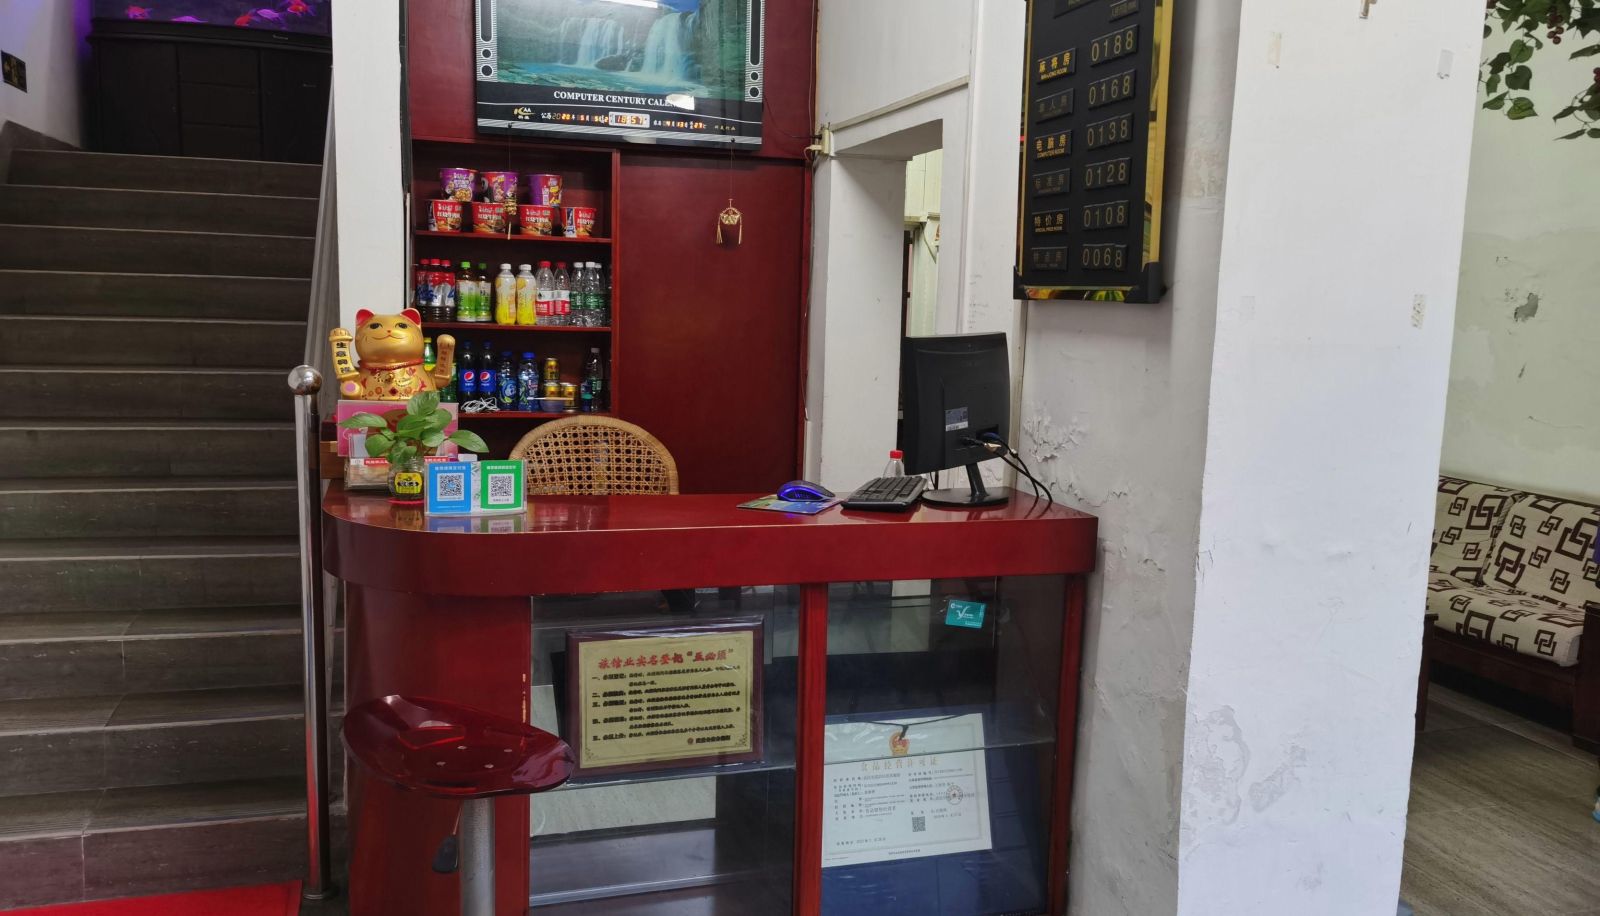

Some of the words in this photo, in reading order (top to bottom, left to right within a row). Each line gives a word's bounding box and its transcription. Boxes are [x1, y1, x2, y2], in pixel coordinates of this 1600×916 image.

[1091, 30, 1133, 62] 0188
[553, 90, 605, 103] COMPUTER
[605, 94, 647, 106] CENTURY
[1089, 75, 1131, 105] 0168
[1087, 119, 1128, 146] 0138
[1085, 162, 1126, 187] 0128
[1083, 205, 1125, 228] 0108
[1082, 247, 1123, 269] 0068
